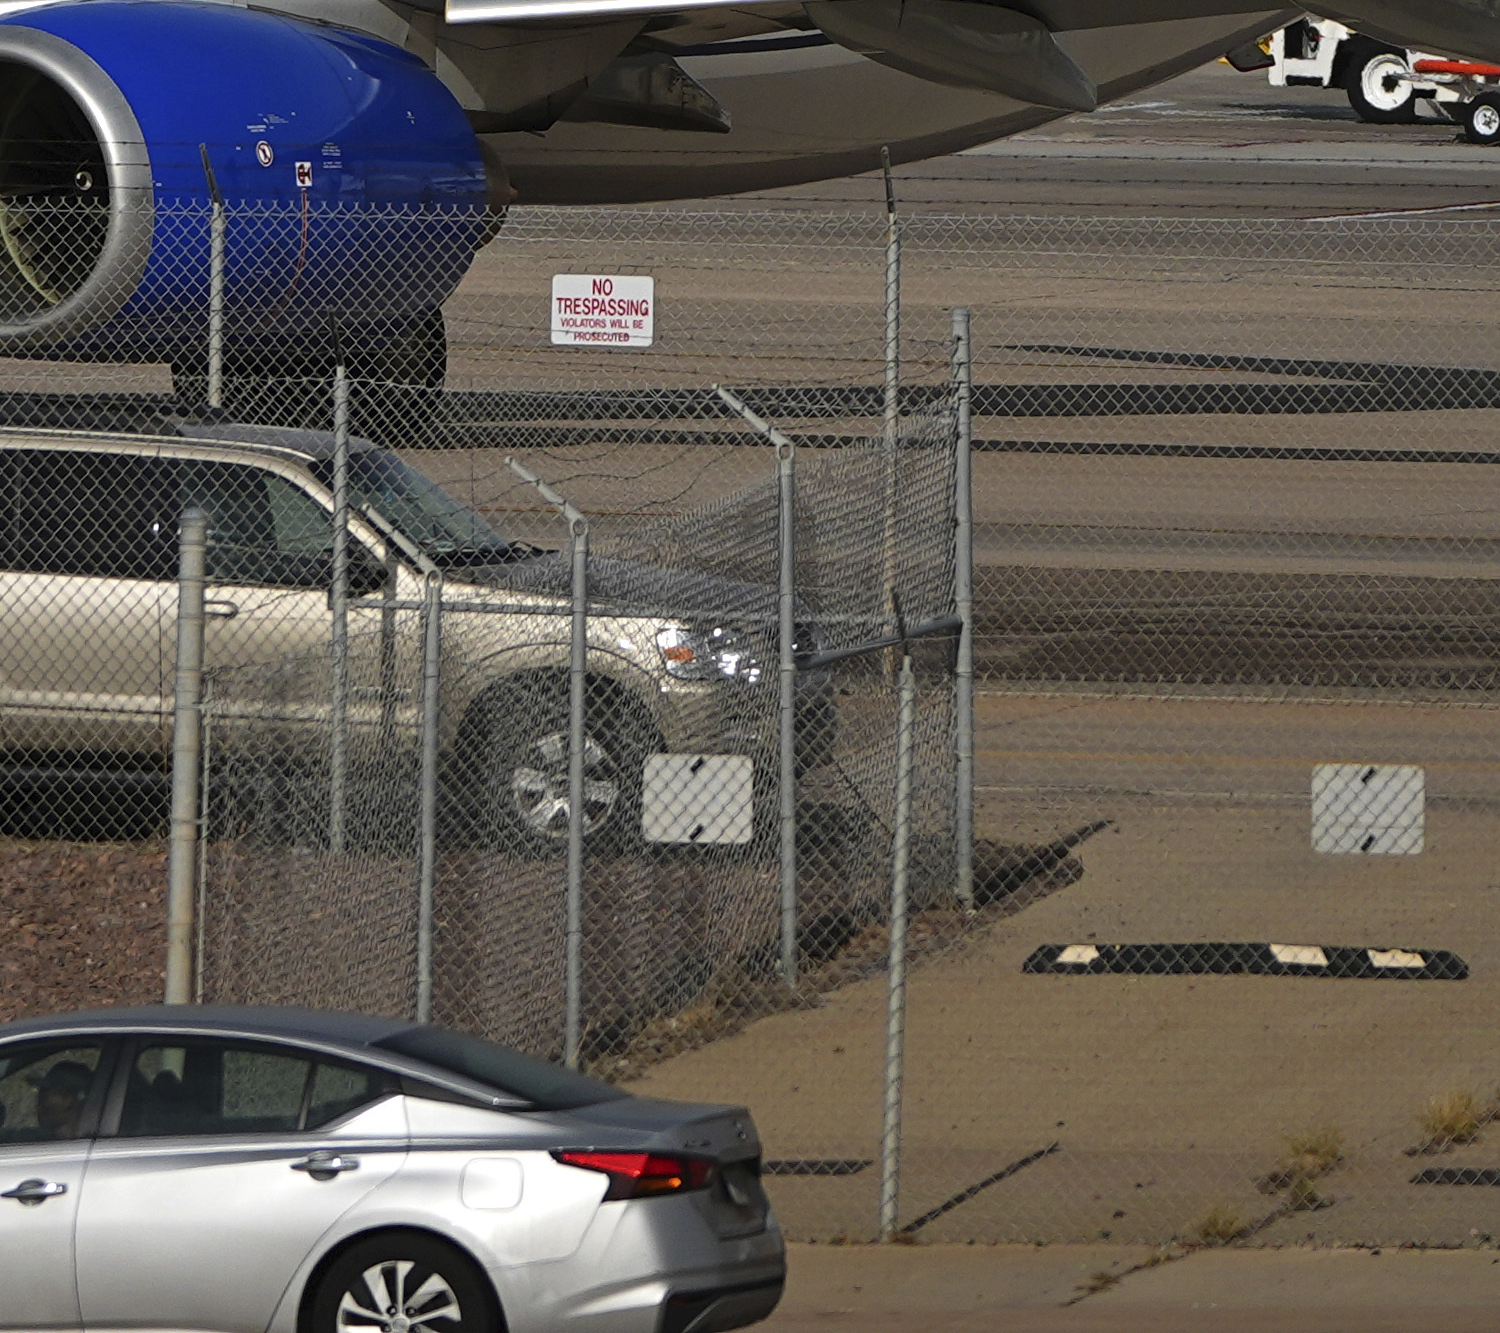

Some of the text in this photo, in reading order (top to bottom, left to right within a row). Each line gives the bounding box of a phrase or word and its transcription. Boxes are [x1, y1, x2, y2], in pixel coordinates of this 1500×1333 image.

[592, 278, 613, 296] NO
[556, 297, 649, 316] TRESPASSING
[561, 317, 643, 329] VIOLATORS WILL BE
[574, 331, 630, 342] PROSECUTED
